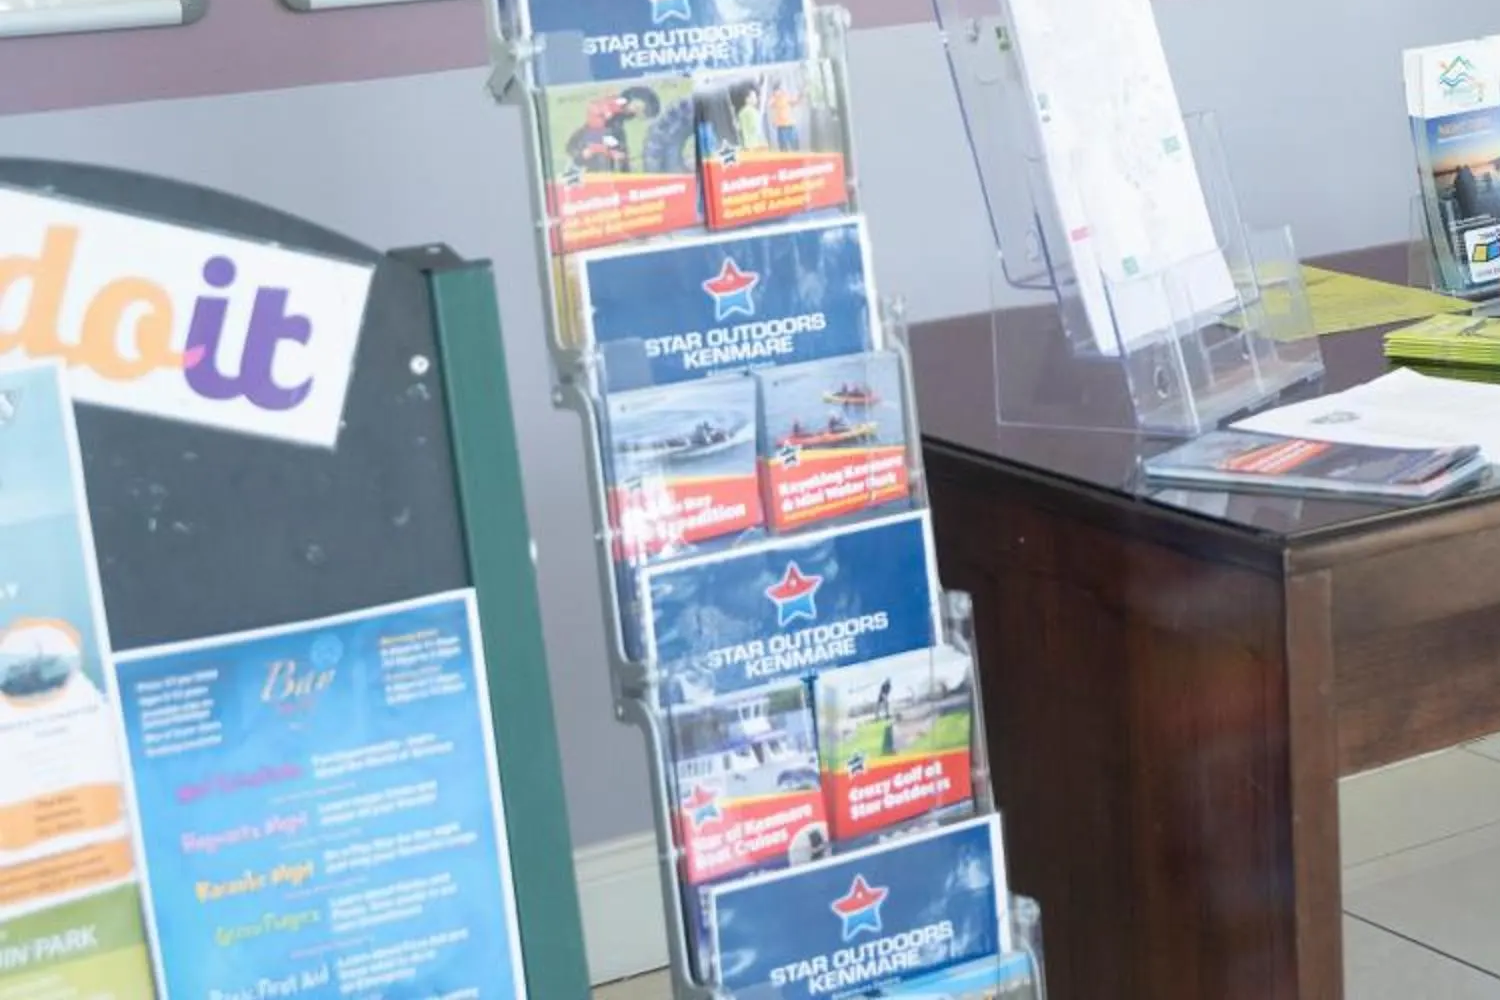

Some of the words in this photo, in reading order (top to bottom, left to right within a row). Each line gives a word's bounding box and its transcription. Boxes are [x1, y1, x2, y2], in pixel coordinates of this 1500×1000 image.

[582, 33, 640, 56] STAR
[643, 21, 764, 49] OUTDOORS
[620, 41, 731, 69] KENMARE
[644, 331, 703, 358] STAR
[706, 311, 827, 347] OUTDOORS
[682, 335, 794, 370] KENMARE
[707, 639, 766, 670] STAR
[769, 611, 889, 654] OUTDOORS
[744, 638, 858, 679] KENMARE
[848, 778, 892, 803] Crazy
[893, 764, 923, 788] Golf
[34, 924, 98, 960] PARK
[770, 955, 829, 988] STAR
[831, 920, 954, 967] OUTDOORS
[808, 949, 921, 996] KENMARE
